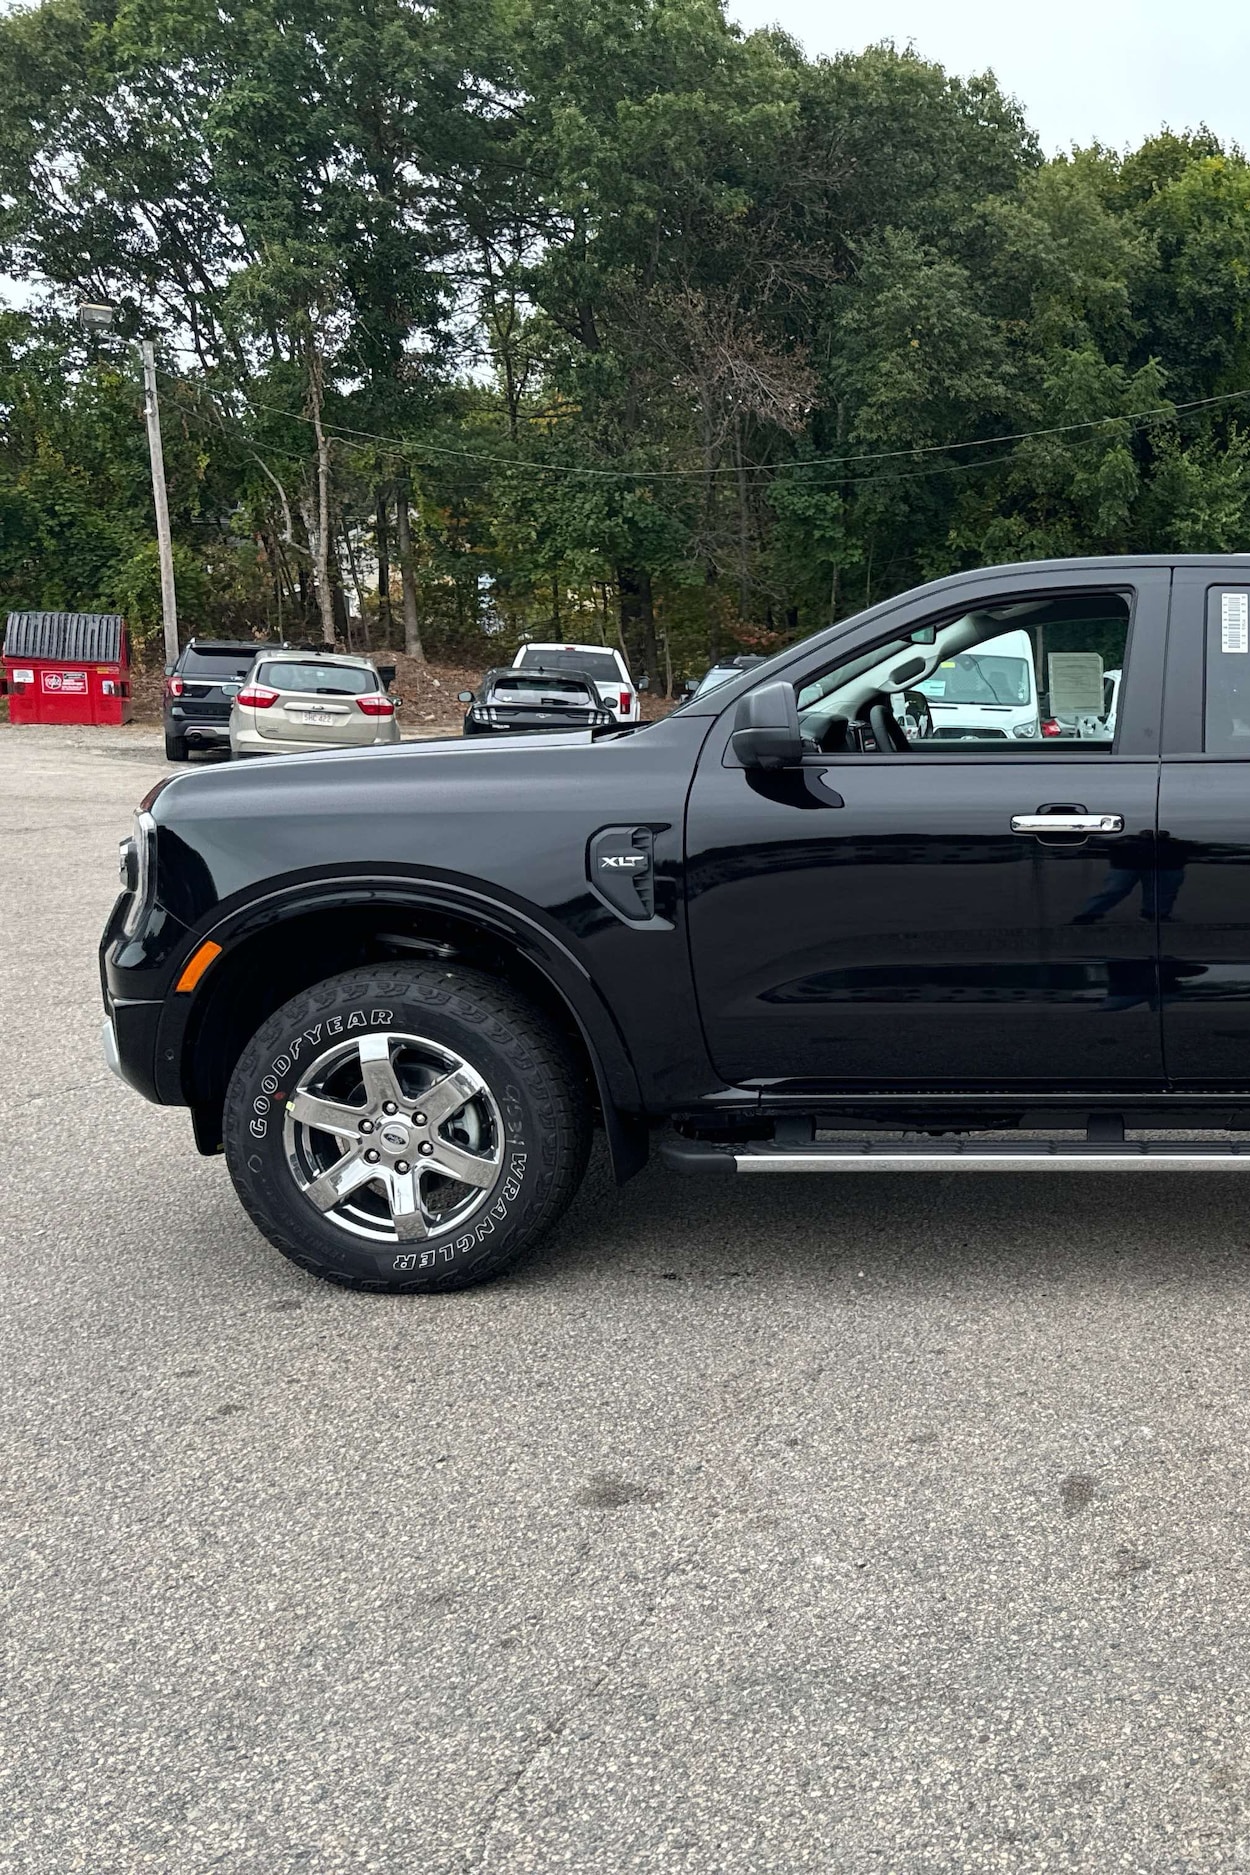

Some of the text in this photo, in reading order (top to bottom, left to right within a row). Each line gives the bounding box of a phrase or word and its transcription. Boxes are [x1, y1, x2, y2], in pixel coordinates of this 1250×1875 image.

[601, 856, 645, 868] XLT
[250, 1008, 394, 1140] GOODYEAR
[393, 1152, 528, 1272] WRANGLER
